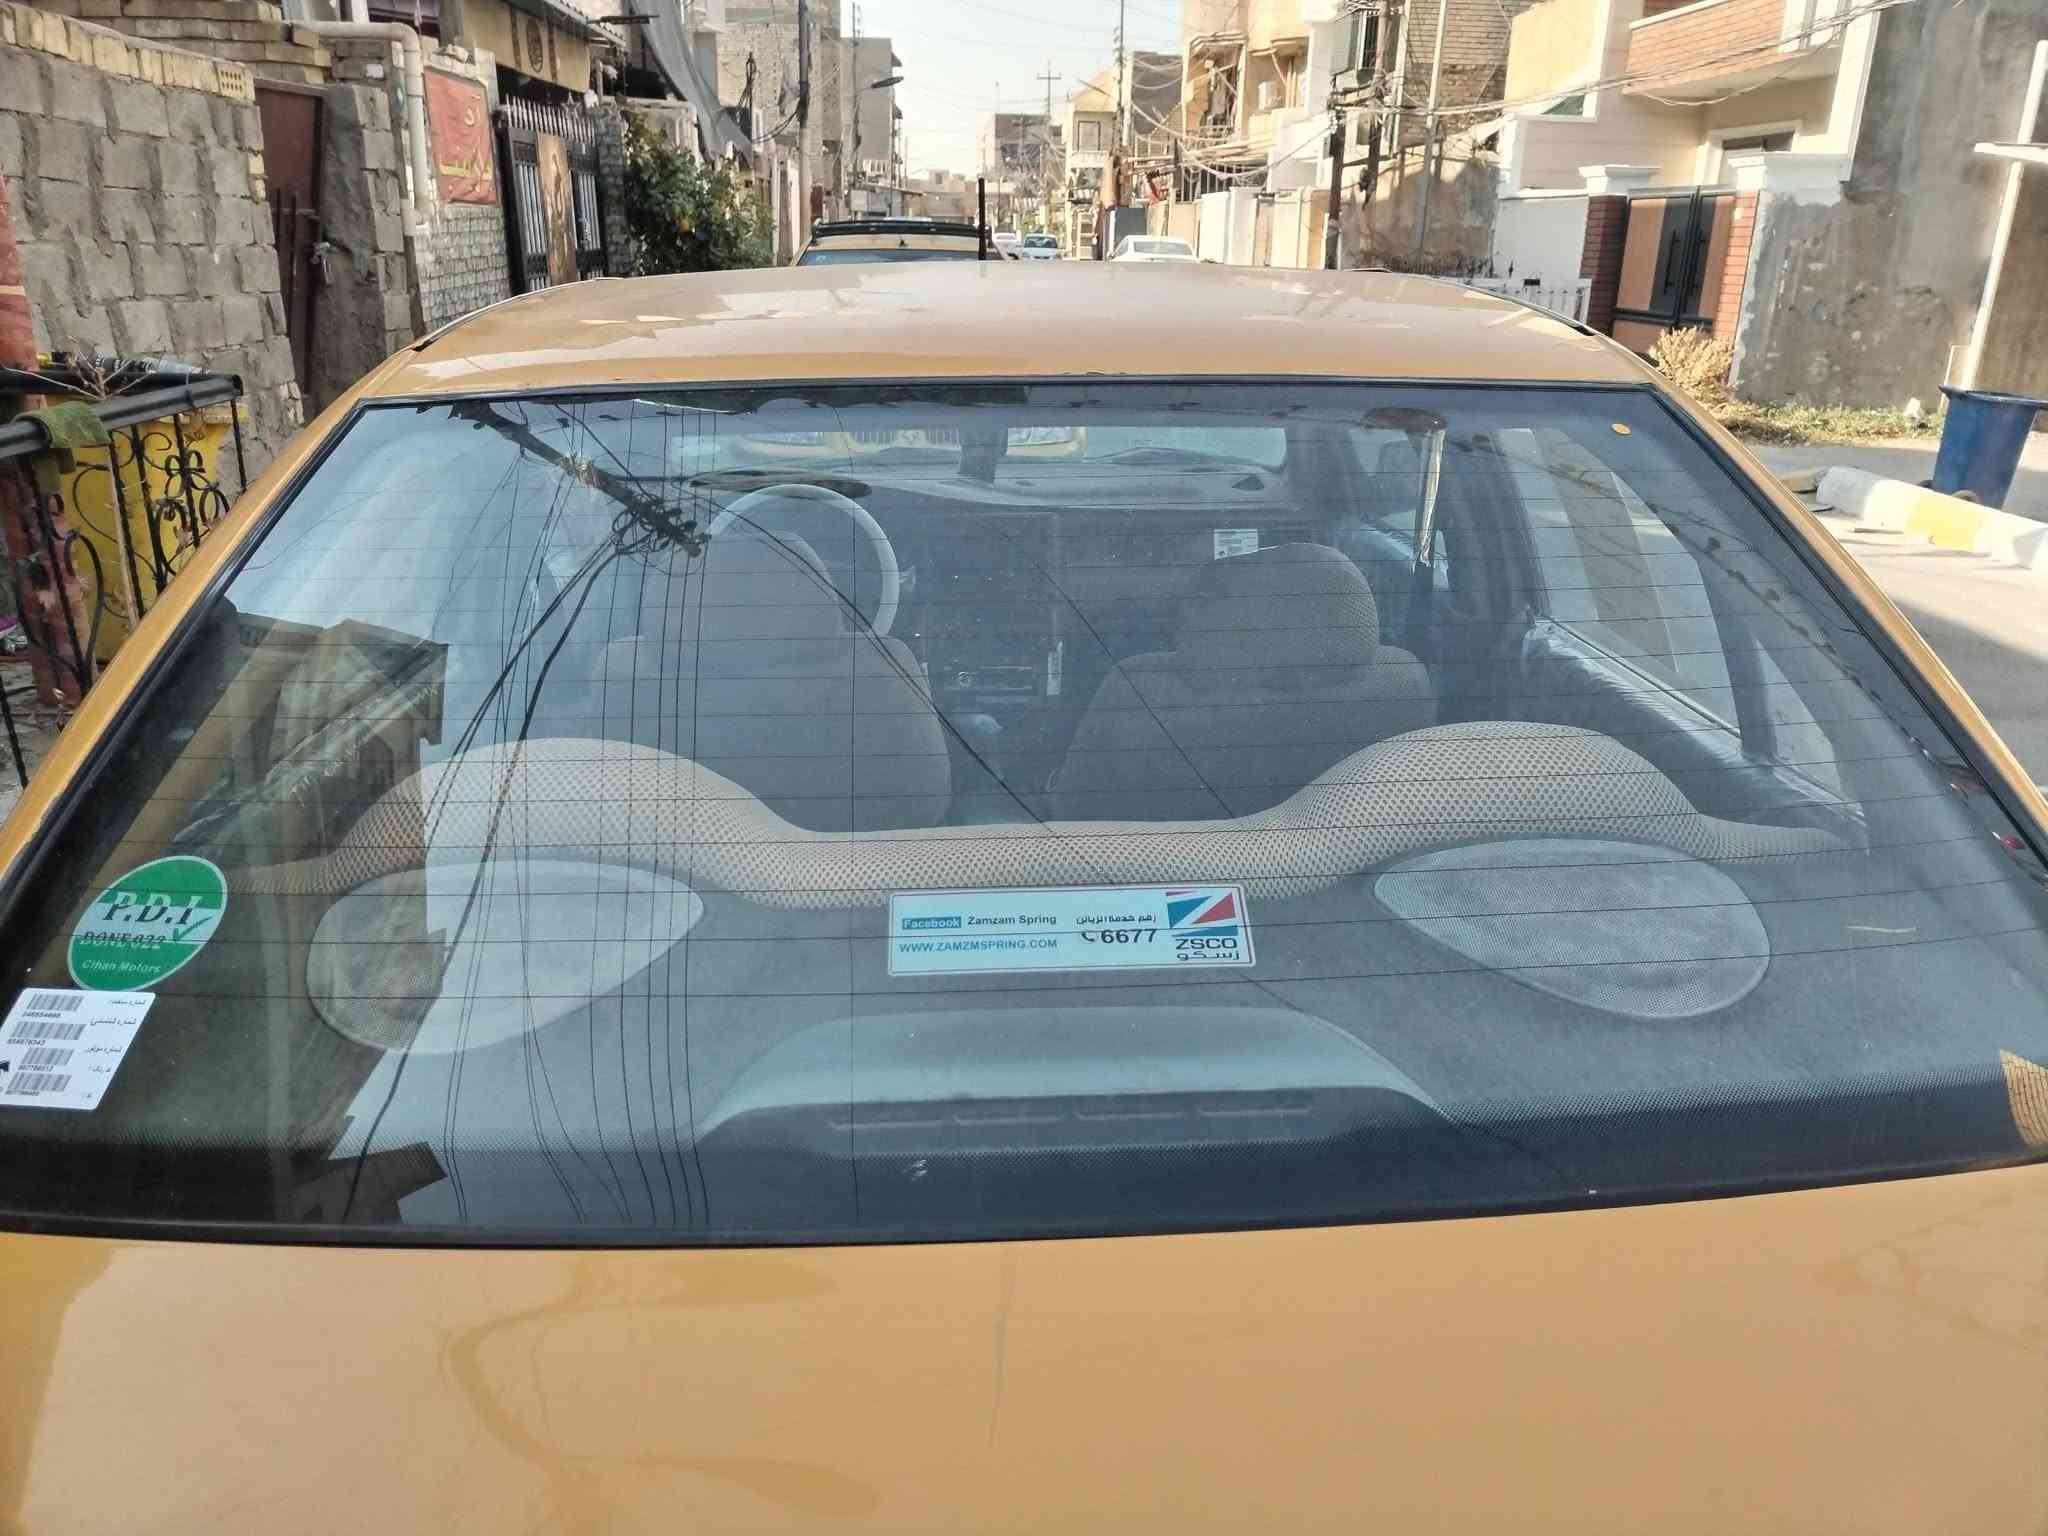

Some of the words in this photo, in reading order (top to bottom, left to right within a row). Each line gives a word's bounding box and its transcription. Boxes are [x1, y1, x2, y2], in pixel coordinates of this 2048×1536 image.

[102, 891, 203, 926] P.D.I
[903, 916, 961, 929] Facebook
[967, 915, 1016, 926] Zamzam
[1018, 914, 1057, 927] Spring
[1137, 914, 1157, 923] رقم
[1101, 928, 1158, 944] 6677
[1175, 937, 1238, 950] ZSCO
[899, 938, 1058, 953] WWW.ZAMZMSPRING.COM
[82, 960, 118, 971] Cihan
[119, 962, 161, 974] Motors
